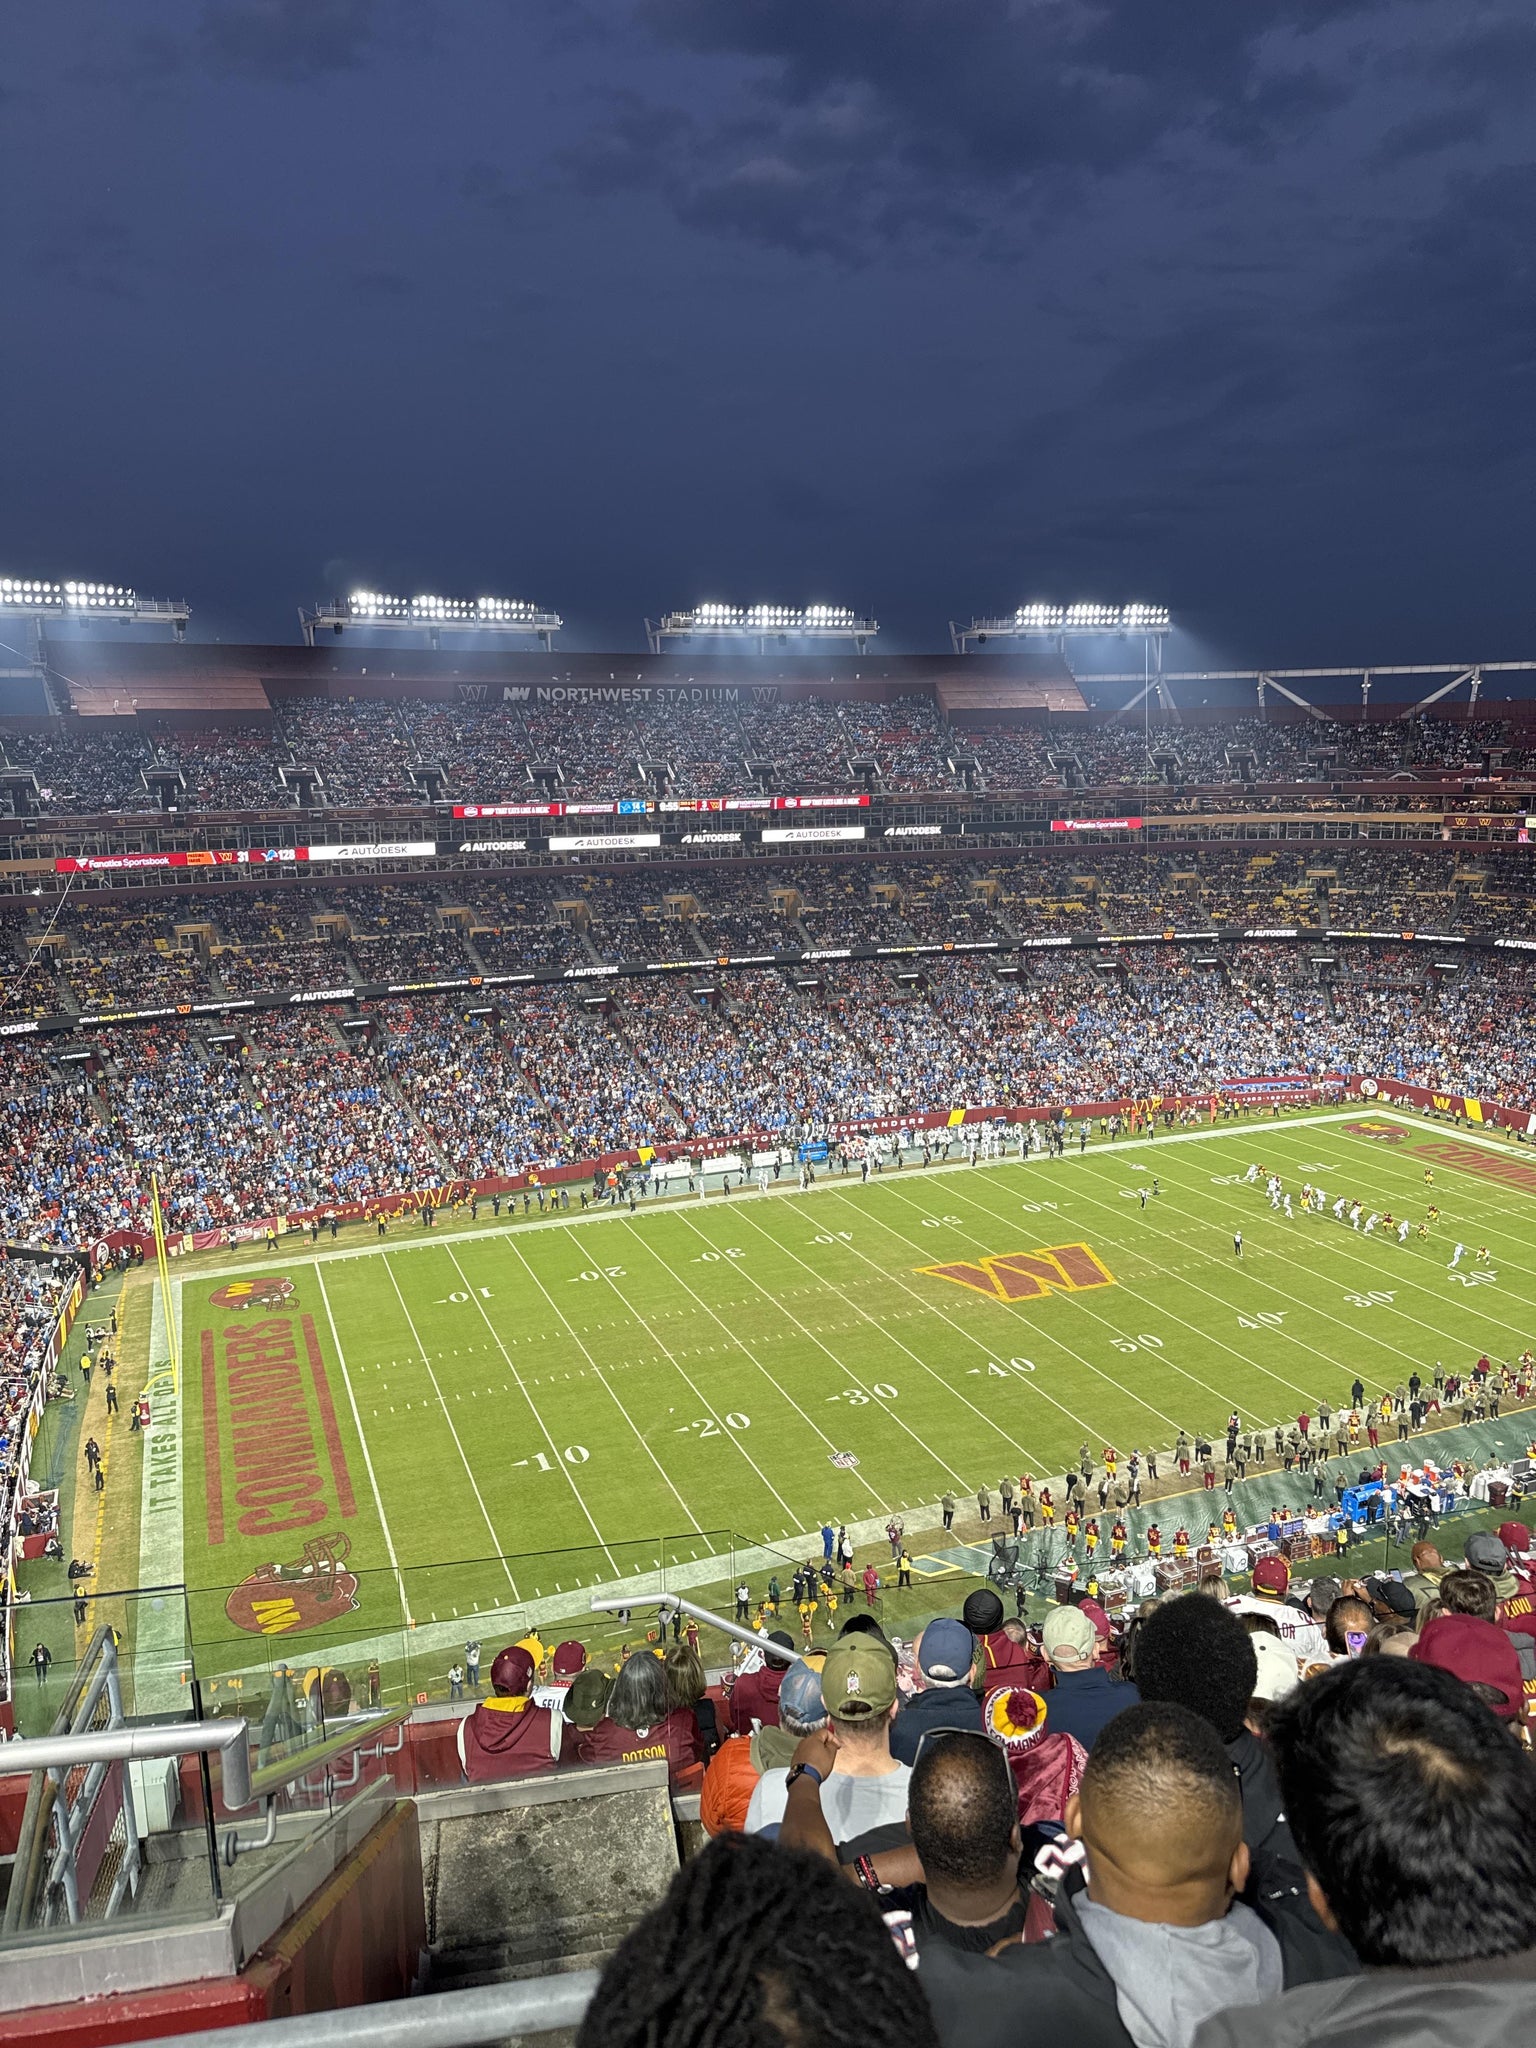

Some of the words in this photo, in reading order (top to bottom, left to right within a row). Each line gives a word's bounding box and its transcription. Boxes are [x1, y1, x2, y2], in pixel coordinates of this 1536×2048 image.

[536, 687, 652, 702] NORTHWEST
[656, 687, 739, 702] STADIUM
[693, 833, 741, 843] AUTODESK
[796, 830, 842, 839] AUTODESK
[895, 825, 942, 836] AUTODESK
[472, 841, 527, 852] AUTODESK
[587, 838, 636, 847] AUTODESK
[237, 851, 249, 862] 31
[279, 849, 296, 860] 128
[352, 846, 408, 856] AUTODESK
[88, 859, 122, 869] Fanatics
[123, 856, 170, 868] Sportsbook
[1255, 929, 1298, 937] AUTODESK
[1032, 937, 1072, 946] AUTODESK
[810, 949, 851, 959] AUTODESK
[574, 966, 619, 977] AUTODESK
[302, 989, 355, 1001] AUTODESK
[830, 1117, 925, 1134] COMMANDERS
[1022, 1200, 1059, 1214] 40
[921, 1214, 964, 1228] 50
[814, 1230, 854, 1245] 40
[701, 1247, 747, 1263] 30
[579, 1265, 627, 1282] 20
[1448, 1270, 1497, 1287] 20
[449, 1286, 495, 1303] 10
[1343, 1290, 1394, 1308] 30
[1237, 1310, 1284, 1330] 40
[1109, 1333, 1164, 1353] 50
[987, 1357, 1036, 1378] 40
[842, 1383, 899, 1405] 30
[152, 1400, 177, 1426] ALL
[223, 1318, 329, 1536] COMMANDERS
[691, 1412, 751, 1438] 20
[150, 1432, 177, 1489] TAKES
[531, 1445, 590, 1472] 10
[150, 1495, 177, 1514] IT
[418, 1693, 427, 1704] G
[622, 1744, 666, 1763] DOTSON
